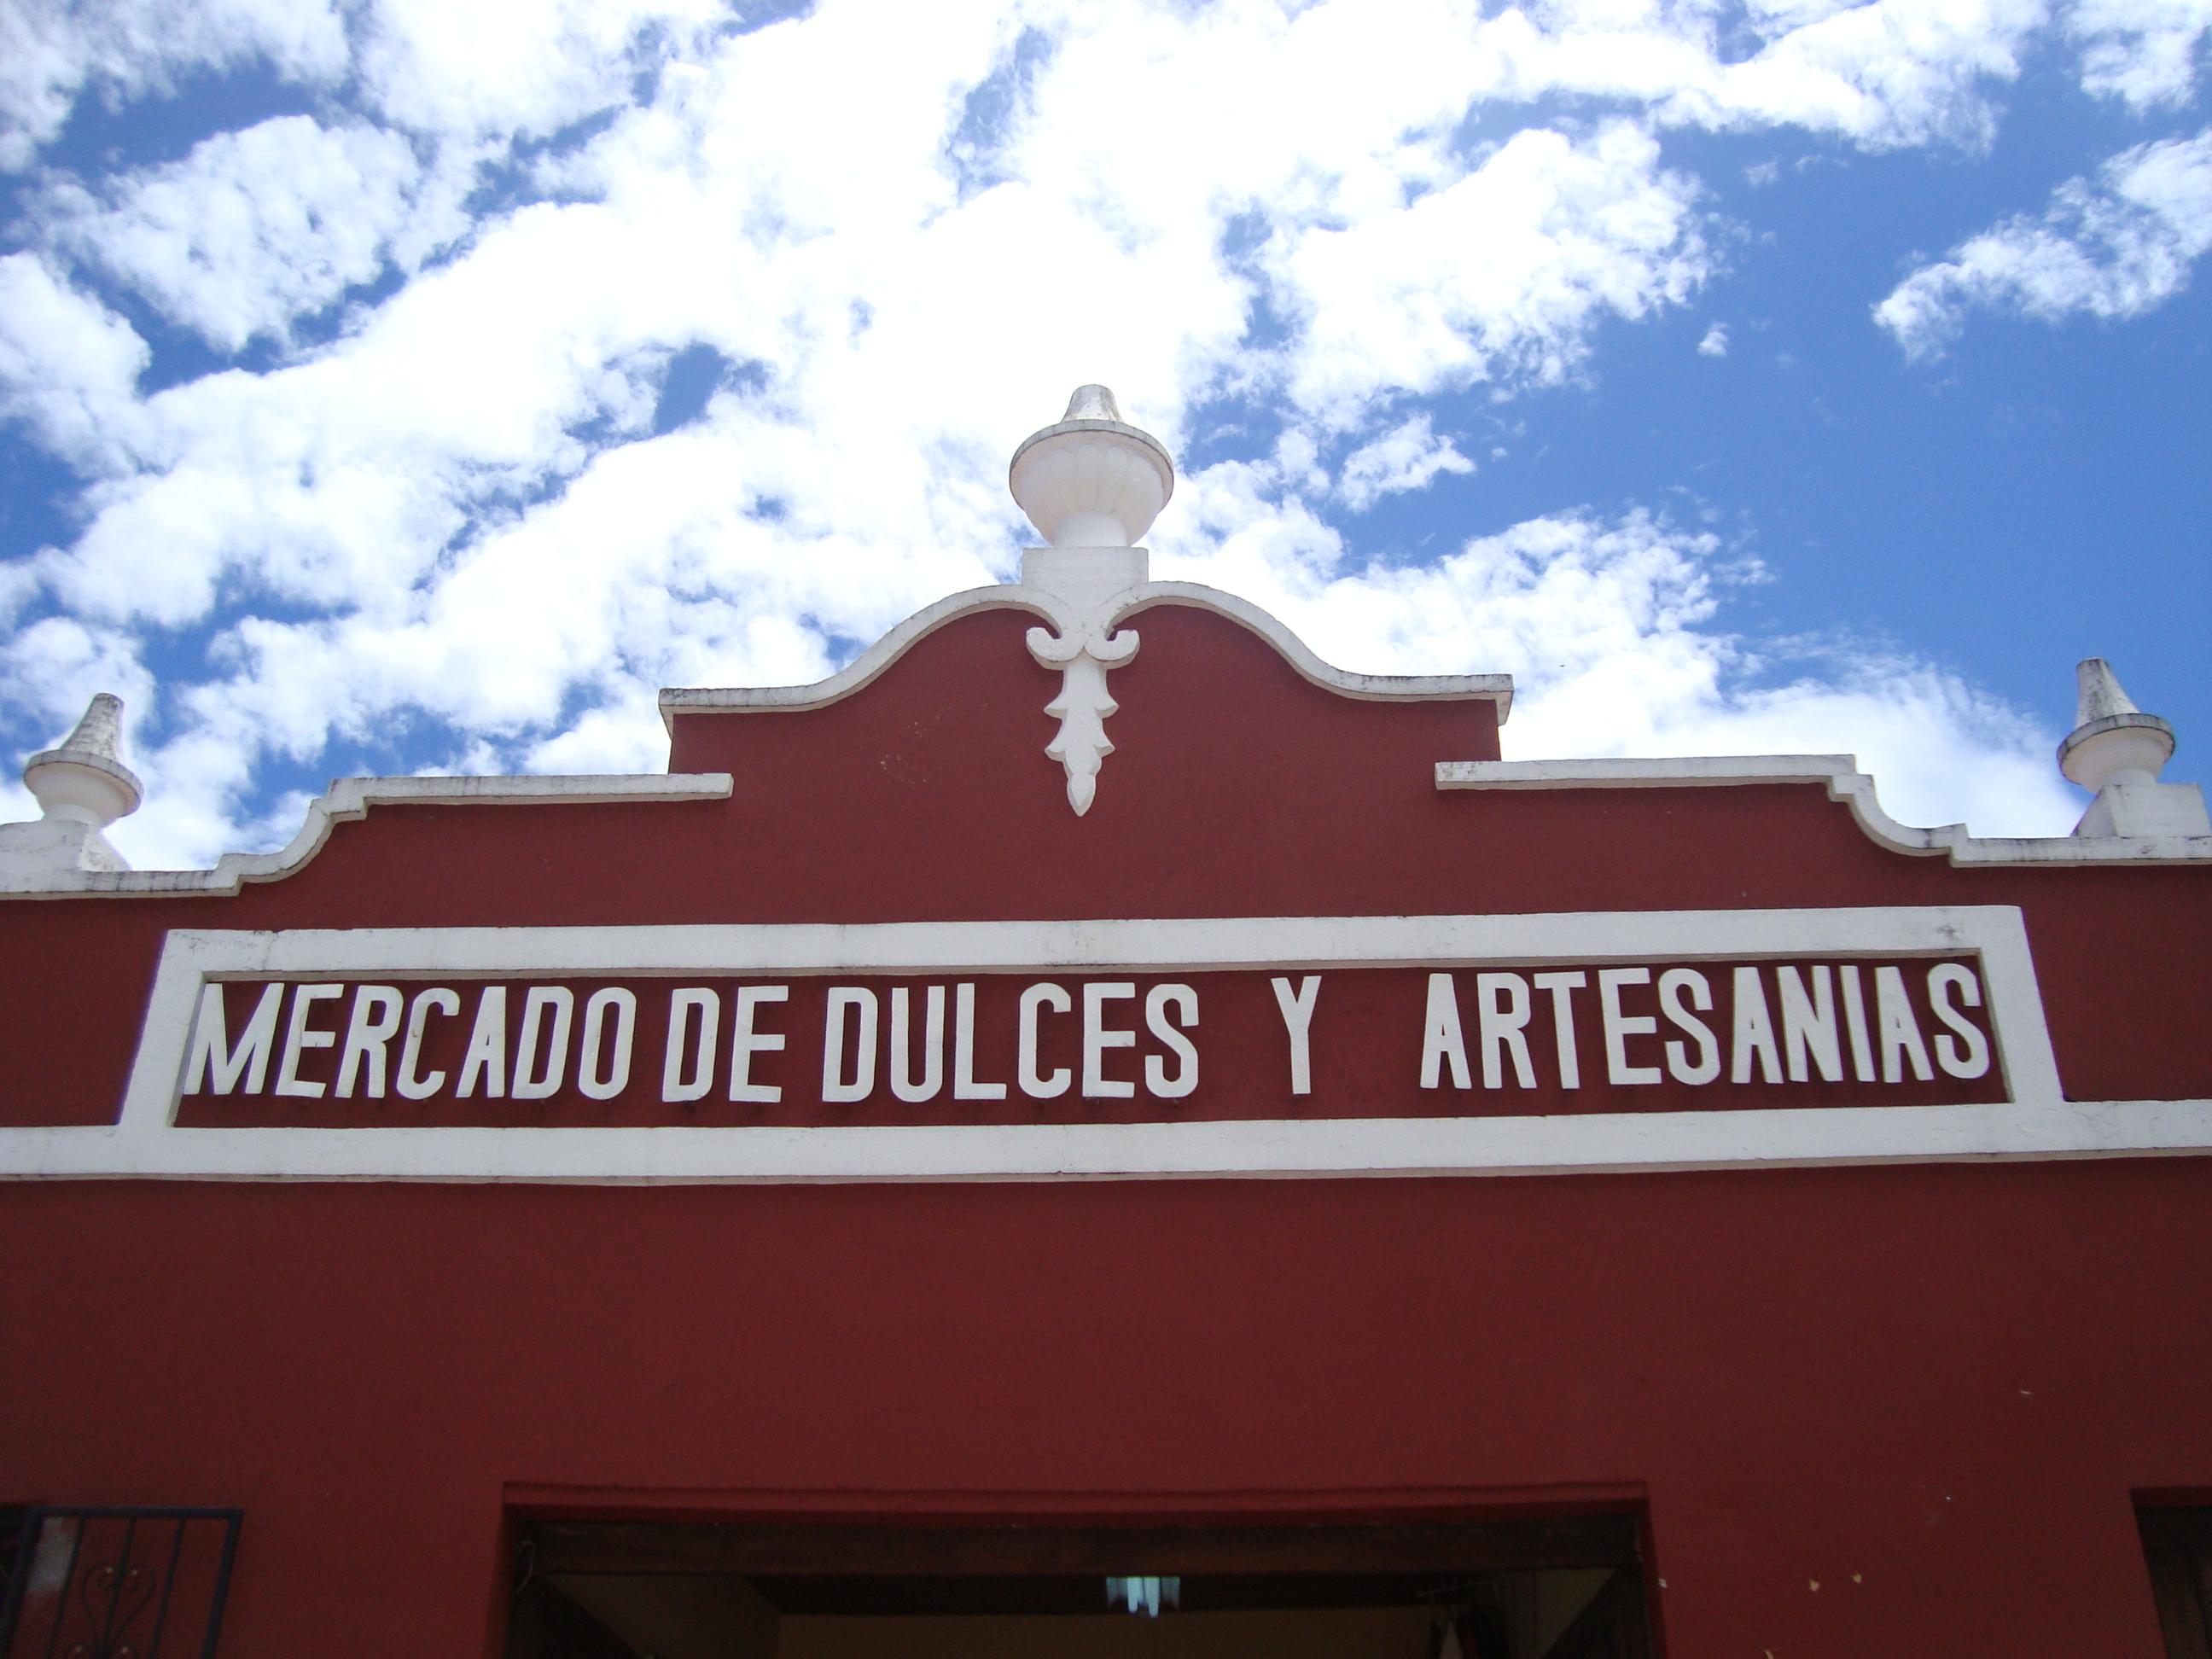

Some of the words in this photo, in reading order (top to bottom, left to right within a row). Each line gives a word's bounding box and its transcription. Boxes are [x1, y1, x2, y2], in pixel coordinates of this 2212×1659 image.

[183, 982, 637, 1101] MERCADO
[661, 986, 790, 1103] DE
[822, 981, 1200, 1103] DULCES
[1271, 975, 1322, 1095] Y
[1418, 962, 1990, 1090] ARTESANIAS
